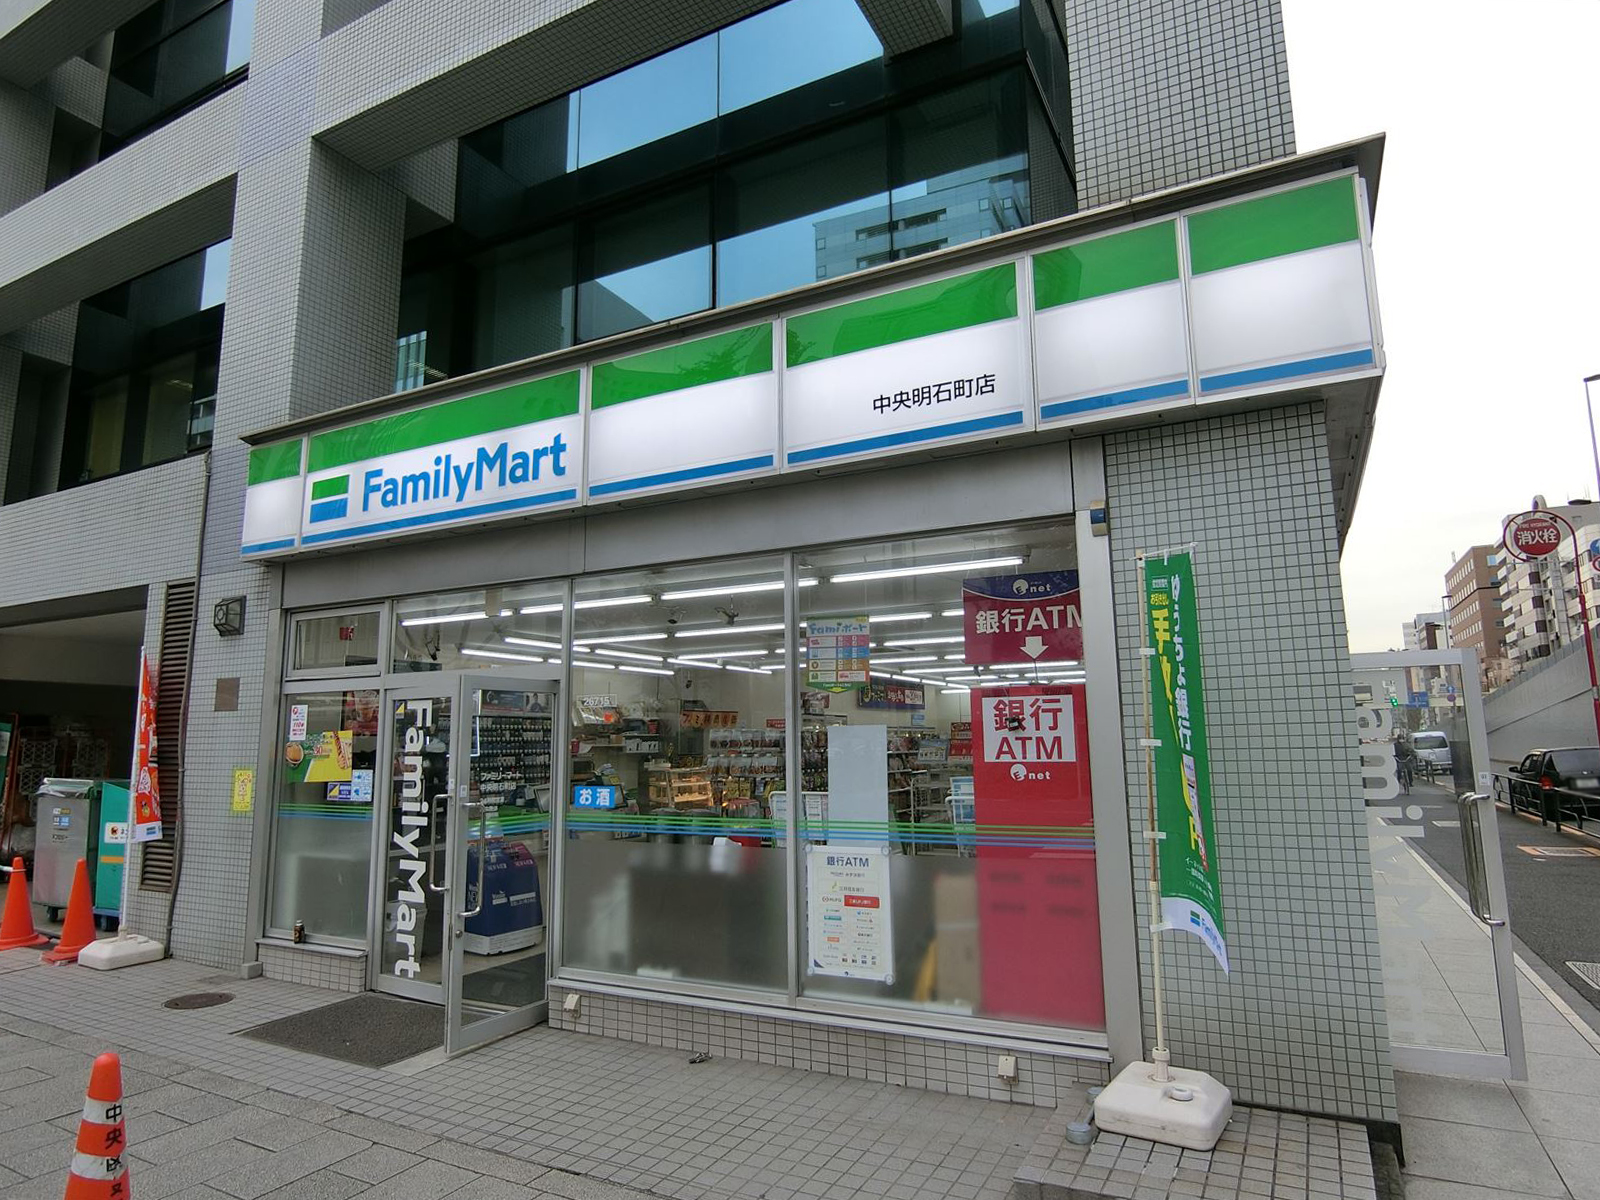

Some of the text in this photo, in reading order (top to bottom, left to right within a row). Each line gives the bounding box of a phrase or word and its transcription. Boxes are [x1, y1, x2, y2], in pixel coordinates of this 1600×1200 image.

[872, 373, 996, 415] 中央明石町店
[362, 432, 567, 512] FamilyMart
[1516, 528, 1559, 546] 消火栓
[993, 697, 1063, 732] 銀行
[995, 736, 1063, 760] ATM
[579, 788, 611, 806] お酒
[393, 700, 433, 979] FamilyMart
[826, 855, 870, 867] 銀行ATM
